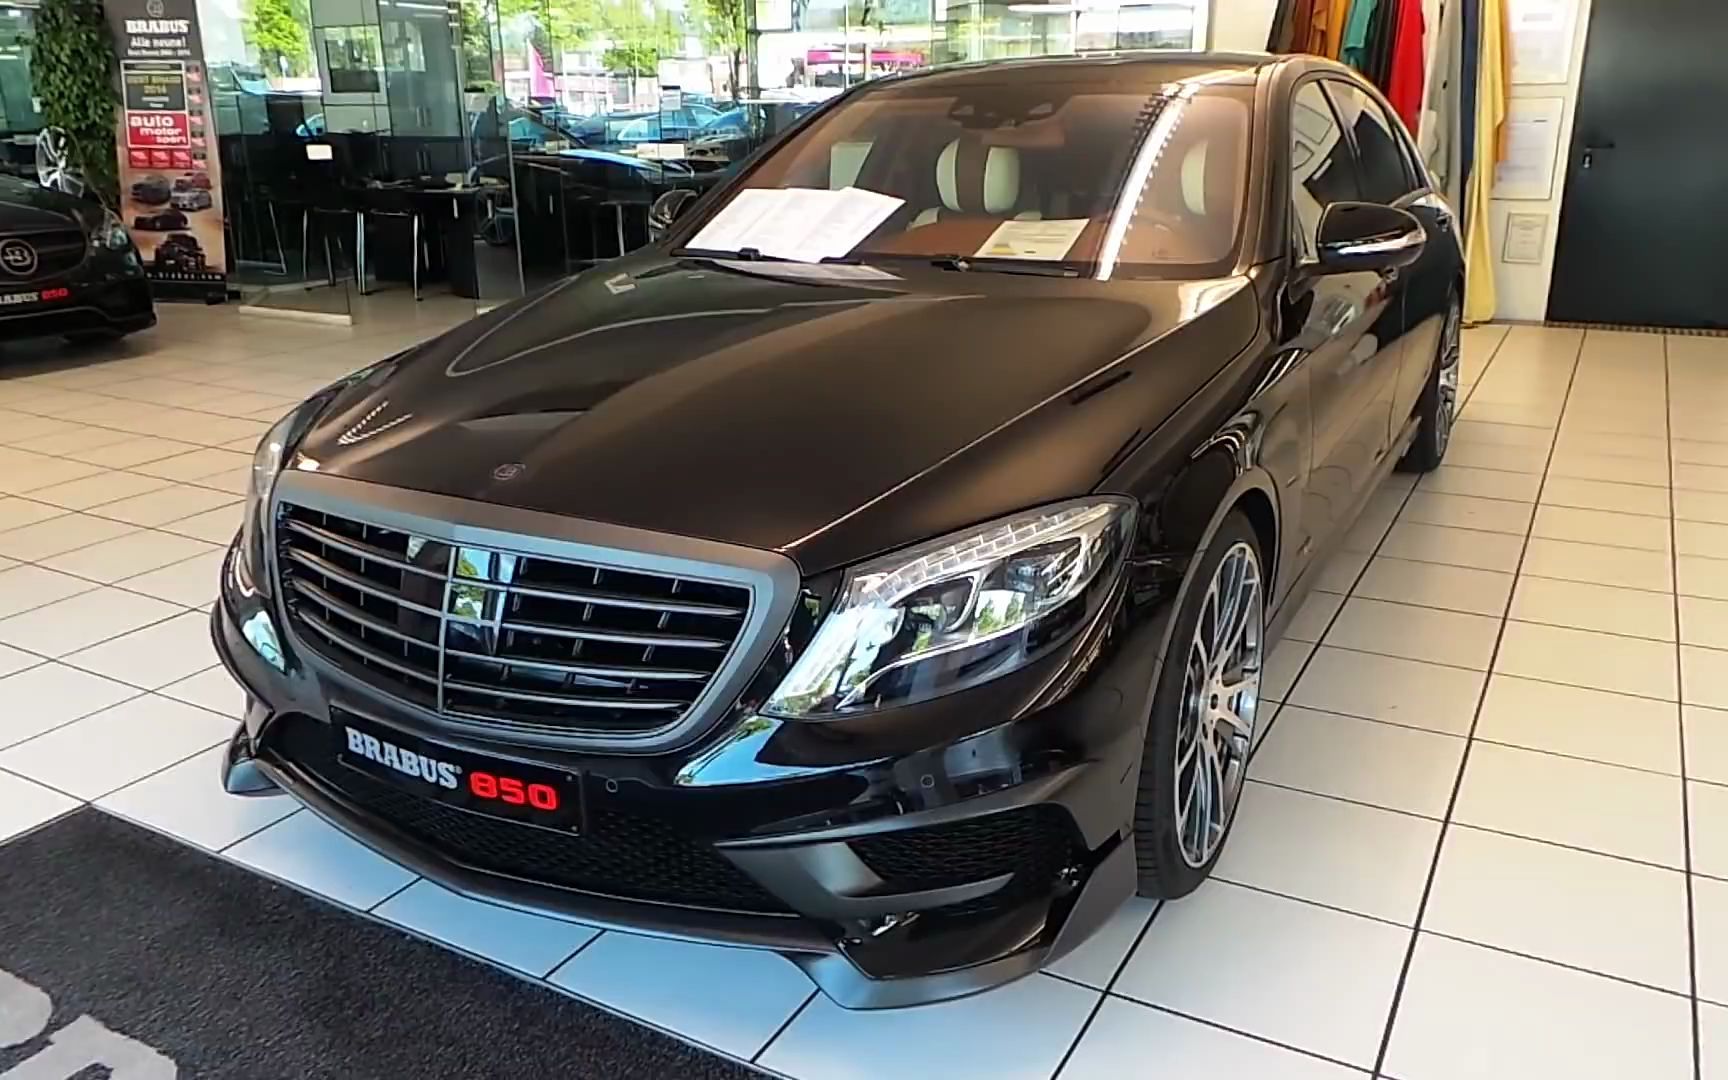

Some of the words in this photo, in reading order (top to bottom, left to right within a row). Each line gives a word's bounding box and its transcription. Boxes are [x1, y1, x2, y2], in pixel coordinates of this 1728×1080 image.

[124, 19, 190, 34] BRABUS
[130, 115, 174, 127] auto
[140, 127, 182, 136] motor
[470, 772, 557, 810] 850
